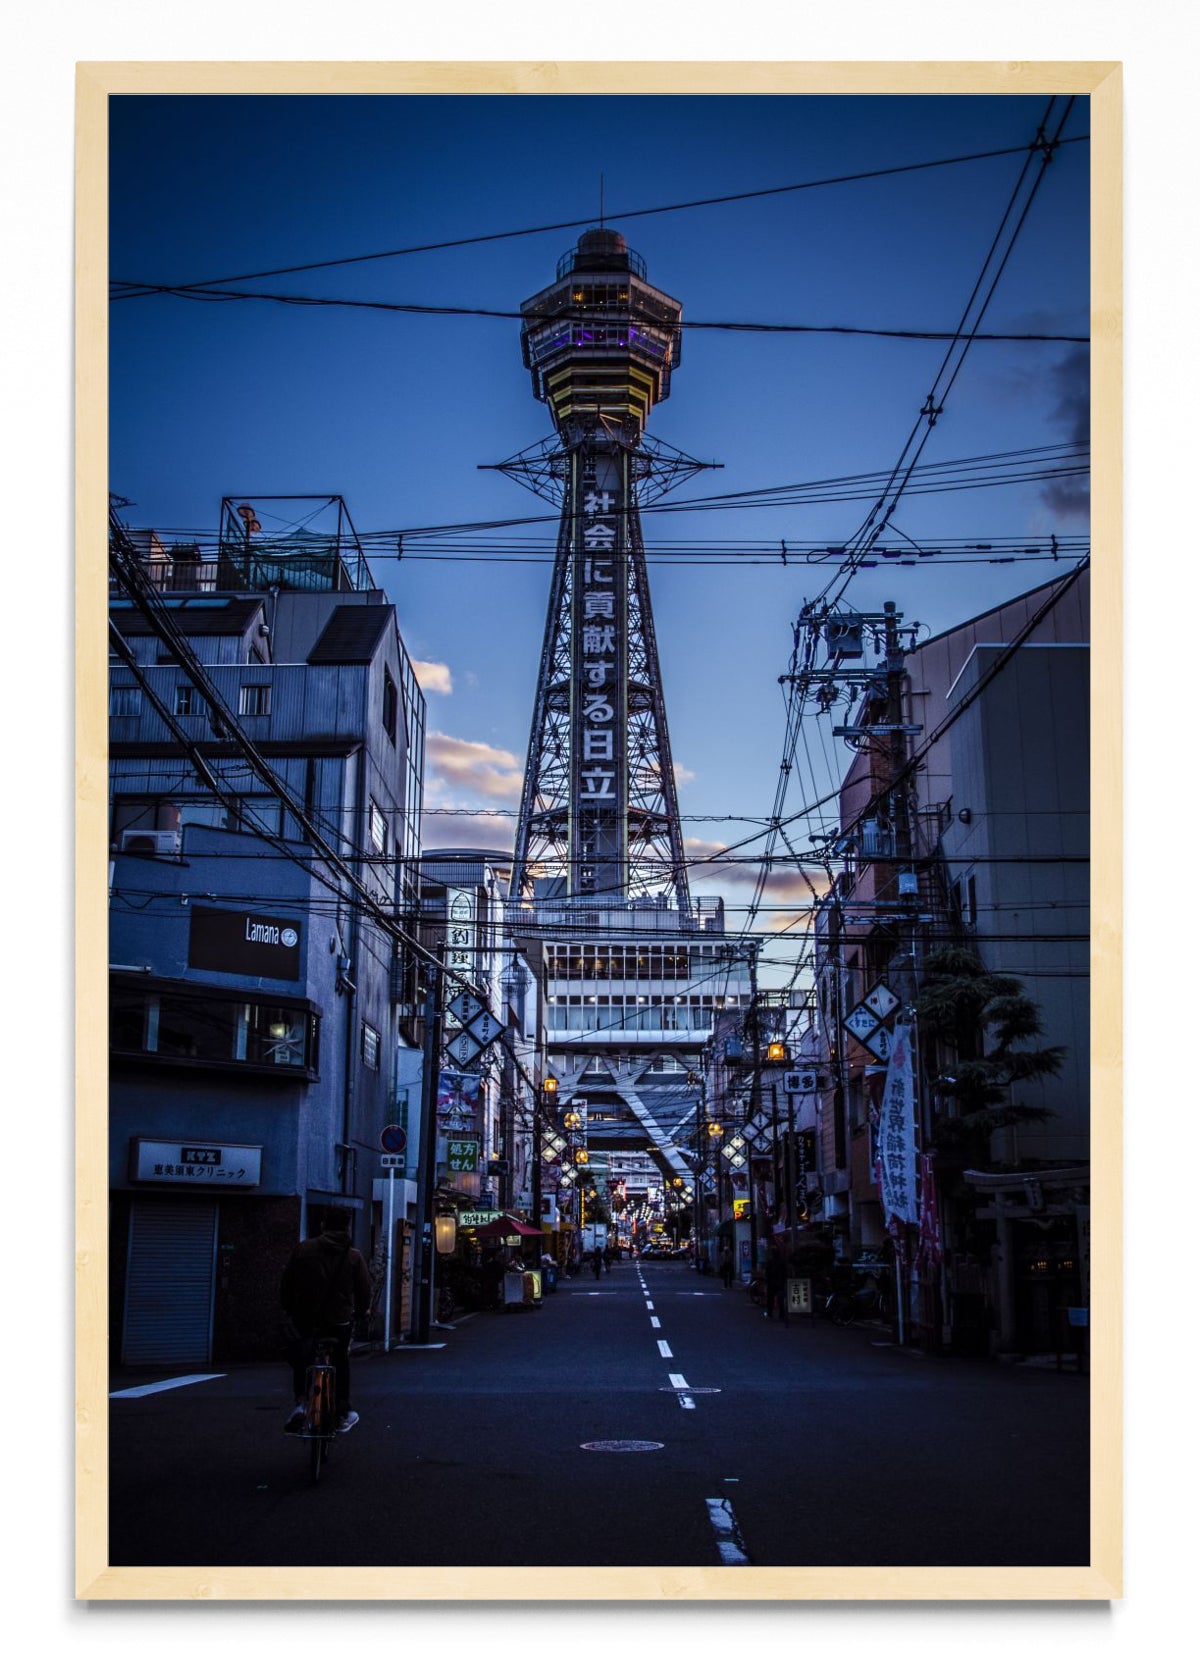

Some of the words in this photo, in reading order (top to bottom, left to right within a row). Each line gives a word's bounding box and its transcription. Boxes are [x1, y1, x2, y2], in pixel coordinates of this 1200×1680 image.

[581, 492, 617, 800] 社会に貢献する日立
[245, 917, 279, 944] Lamana
[450, 1143, 475, 1156] 処方
[153, 1164, 246, 1179] 恵美須東クリニック
[450, 1159, 474, 1170] せん
